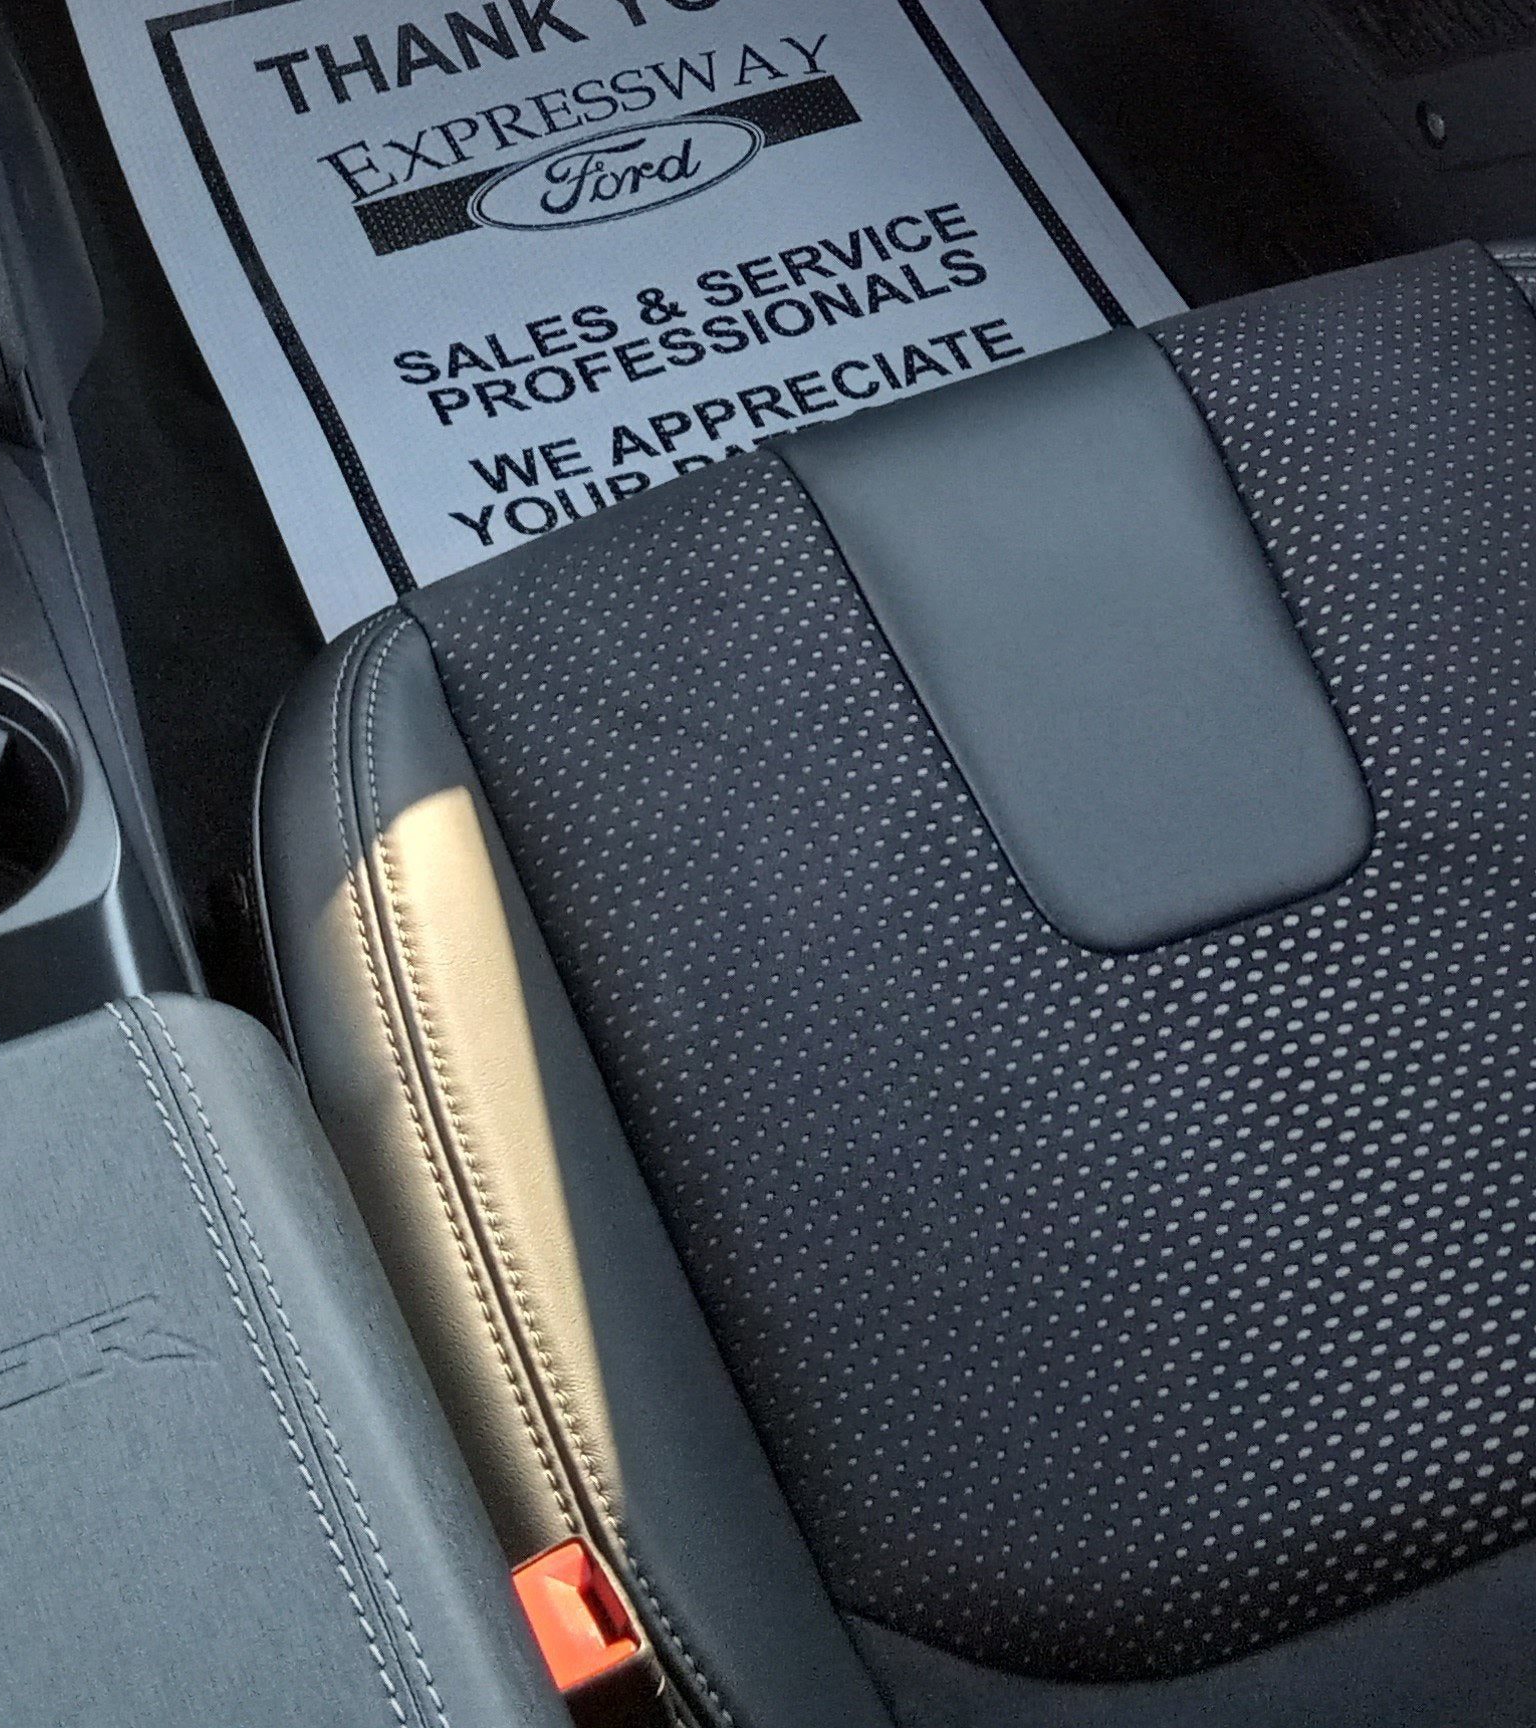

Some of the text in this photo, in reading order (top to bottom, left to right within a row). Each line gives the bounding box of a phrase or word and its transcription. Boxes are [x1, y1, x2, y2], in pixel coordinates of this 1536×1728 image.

[318, 32, 832, 206] EXPRESSWAY
[537, 135, 704, 220] Ford
[391, 201, 978, 387] SALES & SERVICE
[426, 247, 990, 428] PROFESSIONALS
[468, 436, 593, 495] WE
[606, 316, 1027, 467] APPRECIATE
